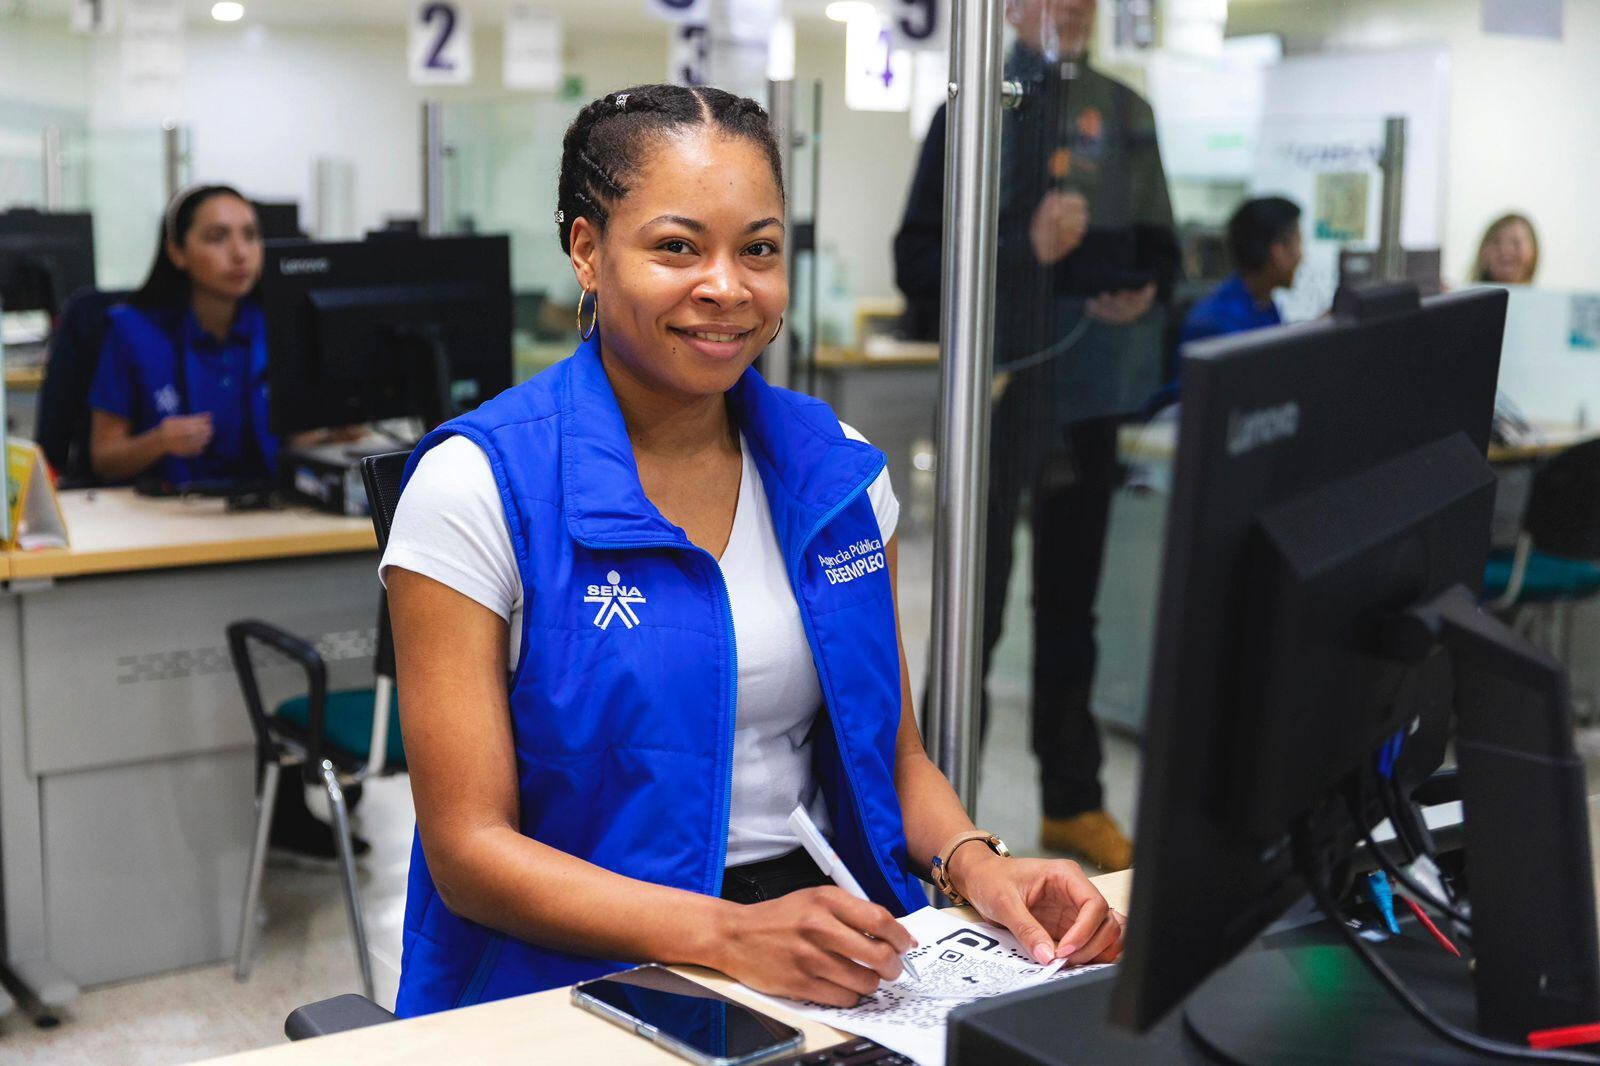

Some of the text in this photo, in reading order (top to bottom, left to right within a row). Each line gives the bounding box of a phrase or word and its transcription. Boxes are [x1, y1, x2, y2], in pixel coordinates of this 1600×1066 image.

[420, 2, 456, 71] 2
[848, 539, 882, 557] Pública
[587, 584, 643, 597] SENA
